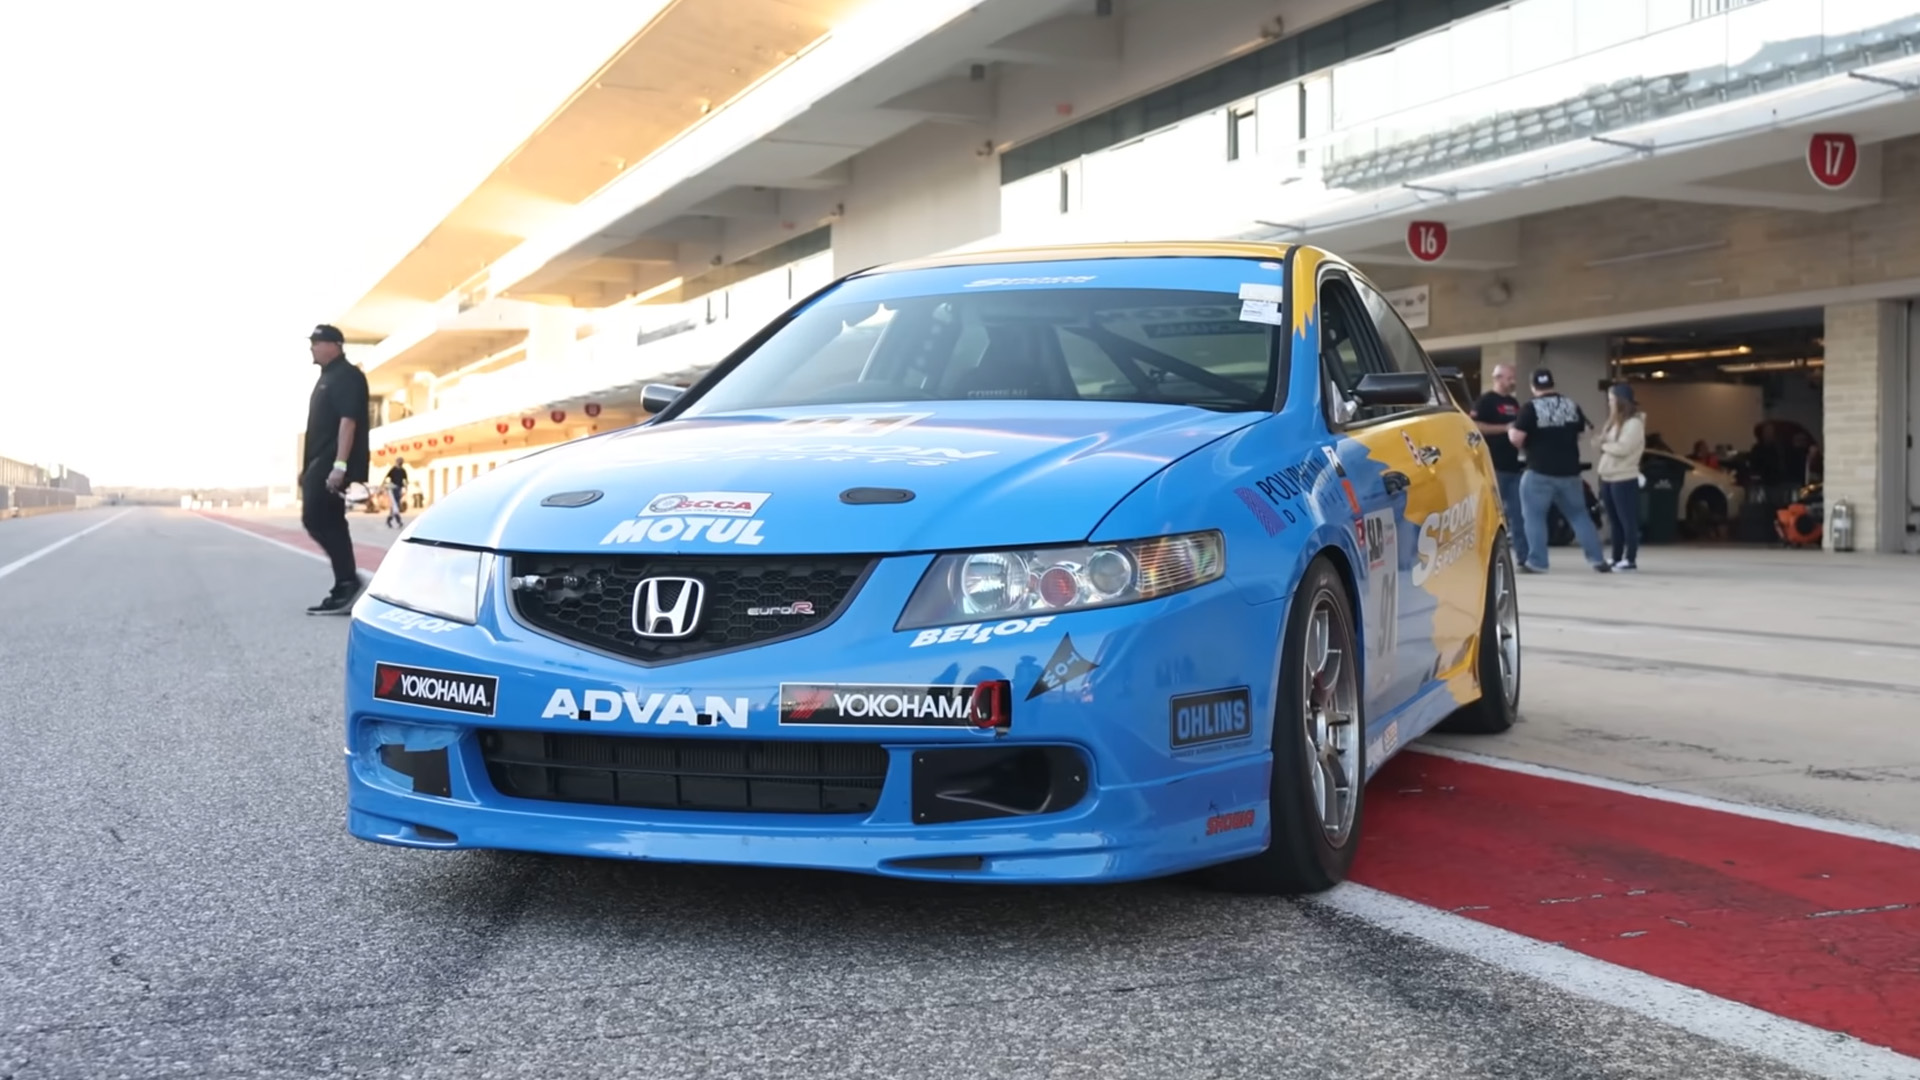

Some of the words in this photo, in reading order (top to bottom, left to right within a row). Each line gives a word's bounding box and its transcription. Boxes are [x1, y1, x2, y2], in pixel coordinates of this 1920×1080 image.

[1824, 140, 1845, 177] 17
[1419, 226, 1437, 255] 16
[674, 499, 752, 511] SCCA
[598, 516, 765, 546] MOTUL
[909, 616, 1057, 648] BELLOF
[401, 673, 487, 707] YOKOHAMA
[541, 688, 749, 729] ADVAN
[1177, 699, 1246, 740] OHLINS
[1206, 809, 1255, 836] SHOWA
